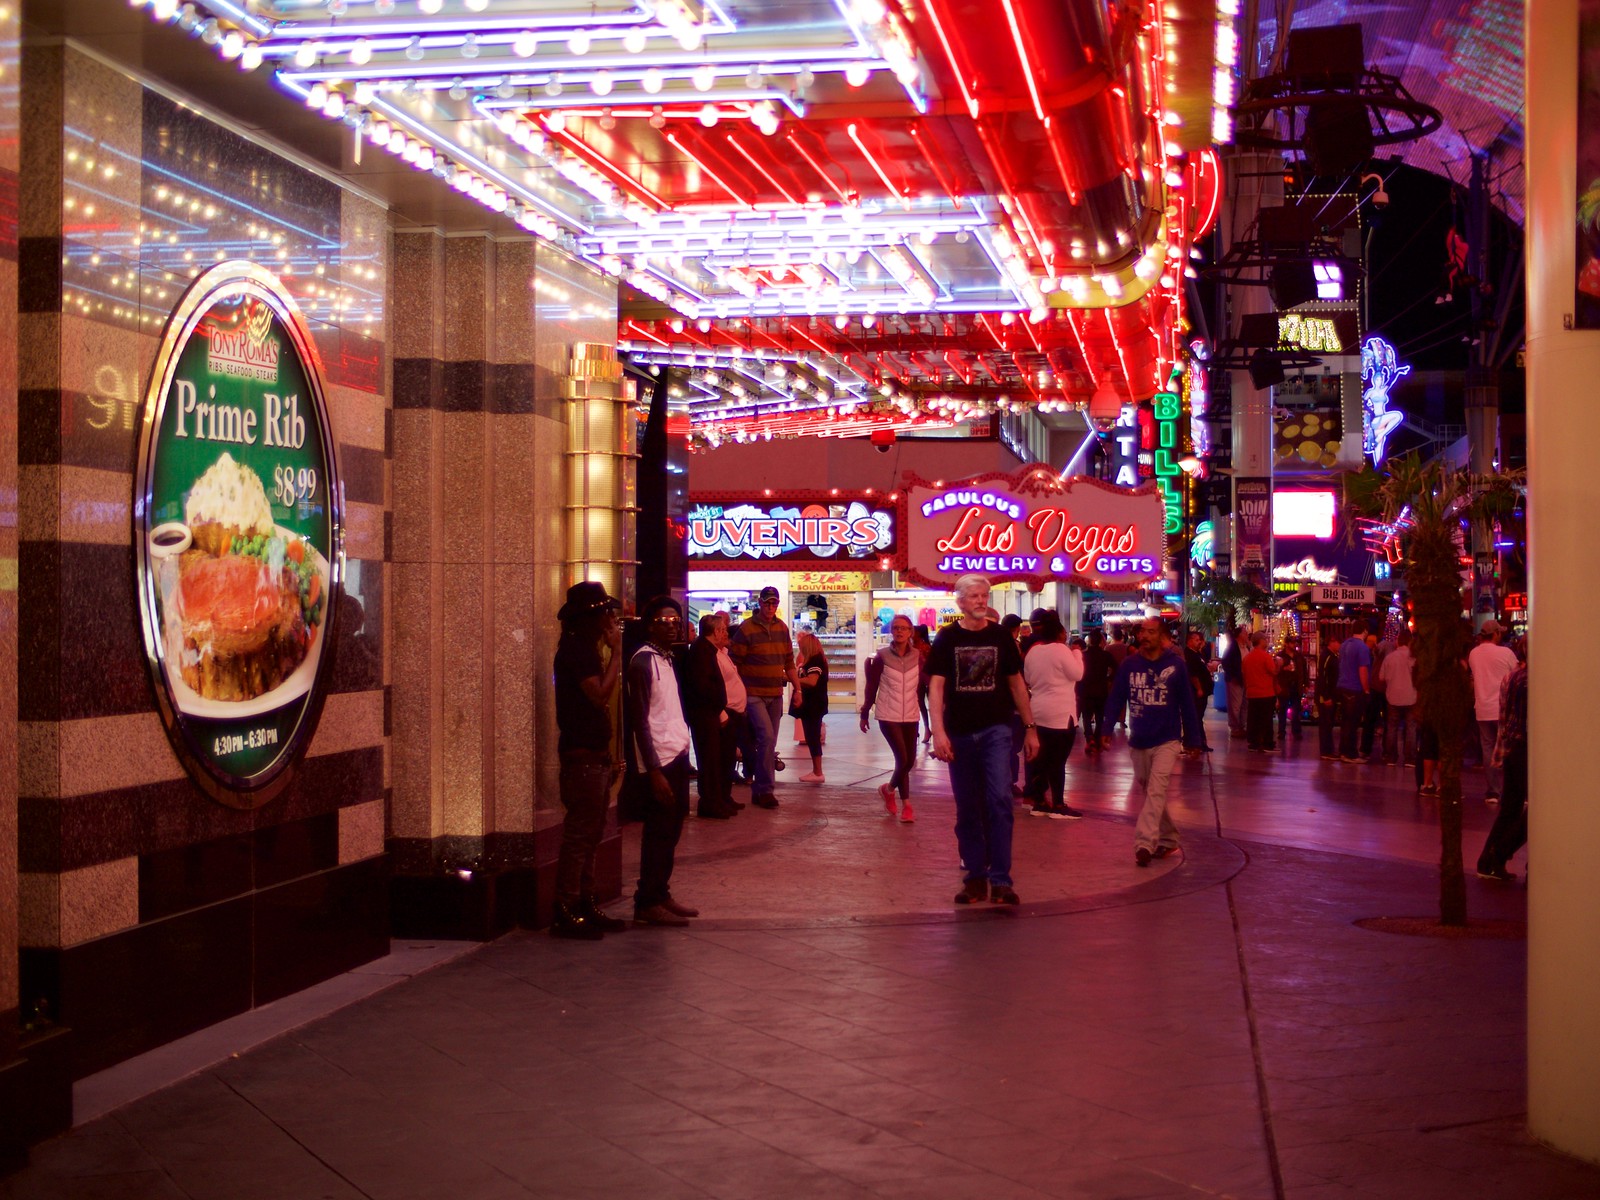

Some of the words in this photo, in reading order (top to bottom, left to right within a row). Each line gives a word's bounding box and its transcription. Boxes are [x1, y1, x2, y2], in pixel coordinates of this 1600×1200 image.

[209, 361, 222, 373] RIBS
[227, 364, 252, 378] SEAFOOD
[256, 369, 277, 382] STEAKS
[175, 379, 257, 446] Prime
[264, 393, 305, 450] Rib
[274, 463, 317, 508] $8.99
[922, 492, 1020, 519] FABULOUS
[1239, 500, 1268, 516] JOIN
[688, 517, 881, 547] UVENIRS
[1242, 516, 1262, 527] THE
[937, 507, 1015, 552] Las
[1027, 508, 1135, 573] Vegas
[938, 557, 1037, 572] JEWELRY
[1050, 557, 1065, 572] &
[1096, 557, 1153, 573] GIFTS
[1323, 589, 1339, 600] Big
[1341, 589, 1365, 600] Balls
[1130, 688, 1168, 706] EAGLE
